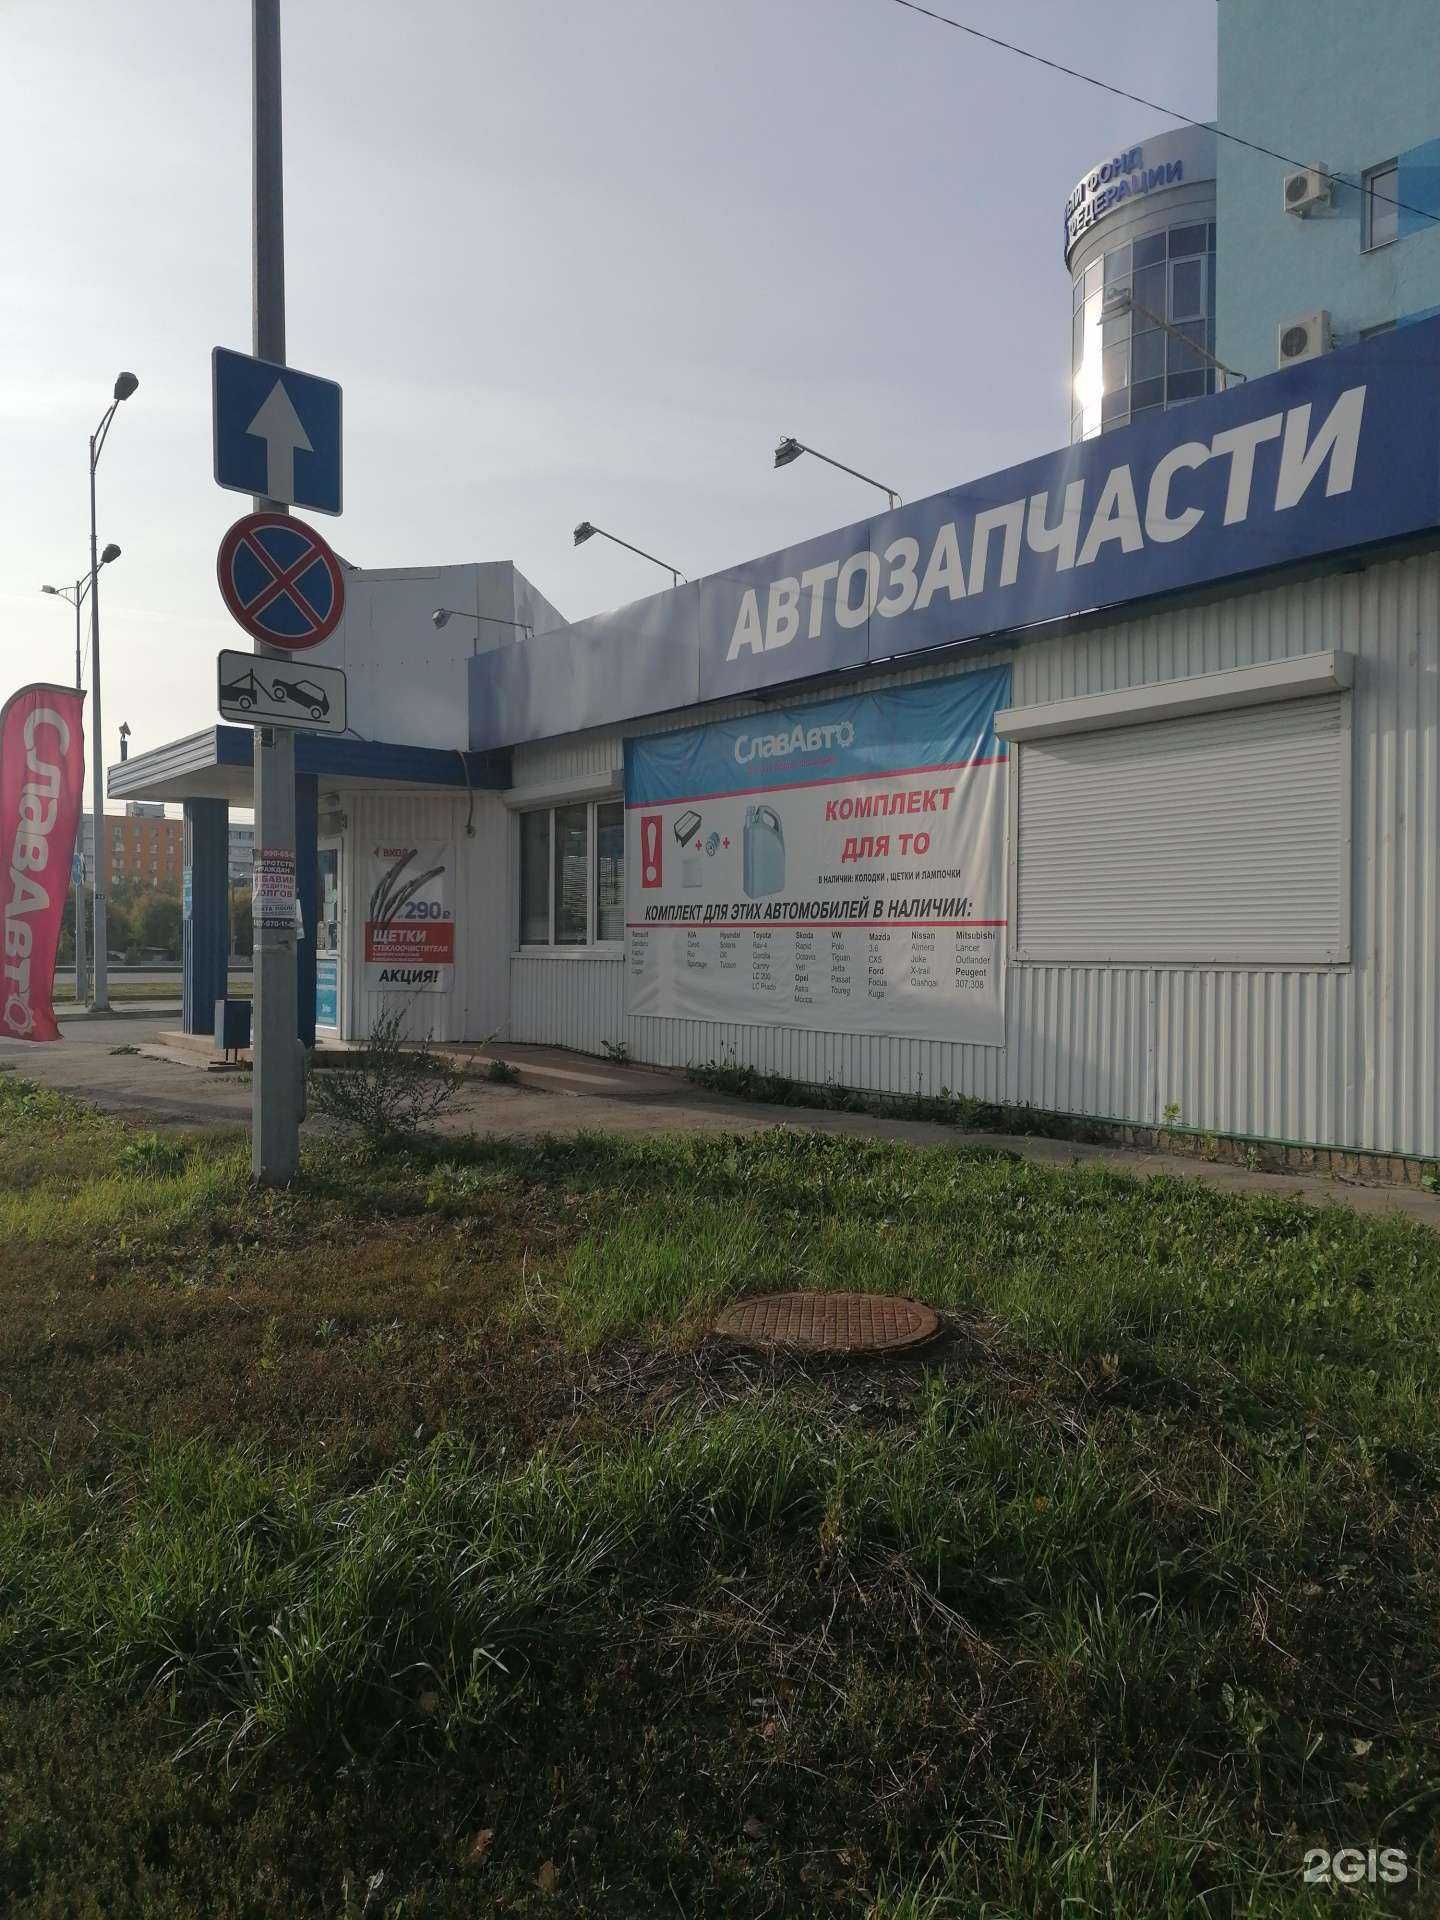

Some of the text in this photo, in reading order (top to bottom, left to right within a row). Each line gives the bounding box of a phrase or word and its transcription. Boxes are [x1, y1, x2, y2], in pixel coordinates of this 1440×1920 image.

[726, 384, 1367, 662] АВТОЗАПЧАСТИ
[825, 787, 955, 822] КОМПЛЕКТ
[841, 832, 930, 863] ДЛЯ ТО
[818, 875, 823, 884] В
[823, 873, 854, 884] НАЛИЧИИ:
[854, 872, 885, 883] КОЛОДКИ
[890, 871, 914, 882] ЩЕТКИ
[914, 872, 921, 880] И
[921, 869, 961, 880] ЛАМПОЧКИ
[404, 901, 442, 920] 290
[645, 895, 974, 924] КОМПЛЕКТ ДЛЯ ЭТИХ АВТОМОБИЛЕЙ В НАЛИЧИИ:
[373, 930, 427, 944] ЩЕТКИ
[753, 931, 772, 940] Toyota
[796, 931, 814, 939] Skoda
[832, 931, 842, 939] VW
[869, 932, 891, 941] Mazda
[911, 931, 936, 940] Nissan
[955, 931, 995, 940] Mitsubishi
[832, 943, 845, 951] Polo
[955, 943, 980, 952] Lancer
[955, 955, 991, 965] Outlander
[868, 966, 884, 975] Ford
[955, 967, 987, 978] Peugeot
[379, 969, 439, 984] АКЦИЯ!
[795, 974, 809, 982] Opel
[831, 975, 851, 984] Passat
[868, 978, 888, 987] Focus
[868, 990, 885, 1000] Kuga
